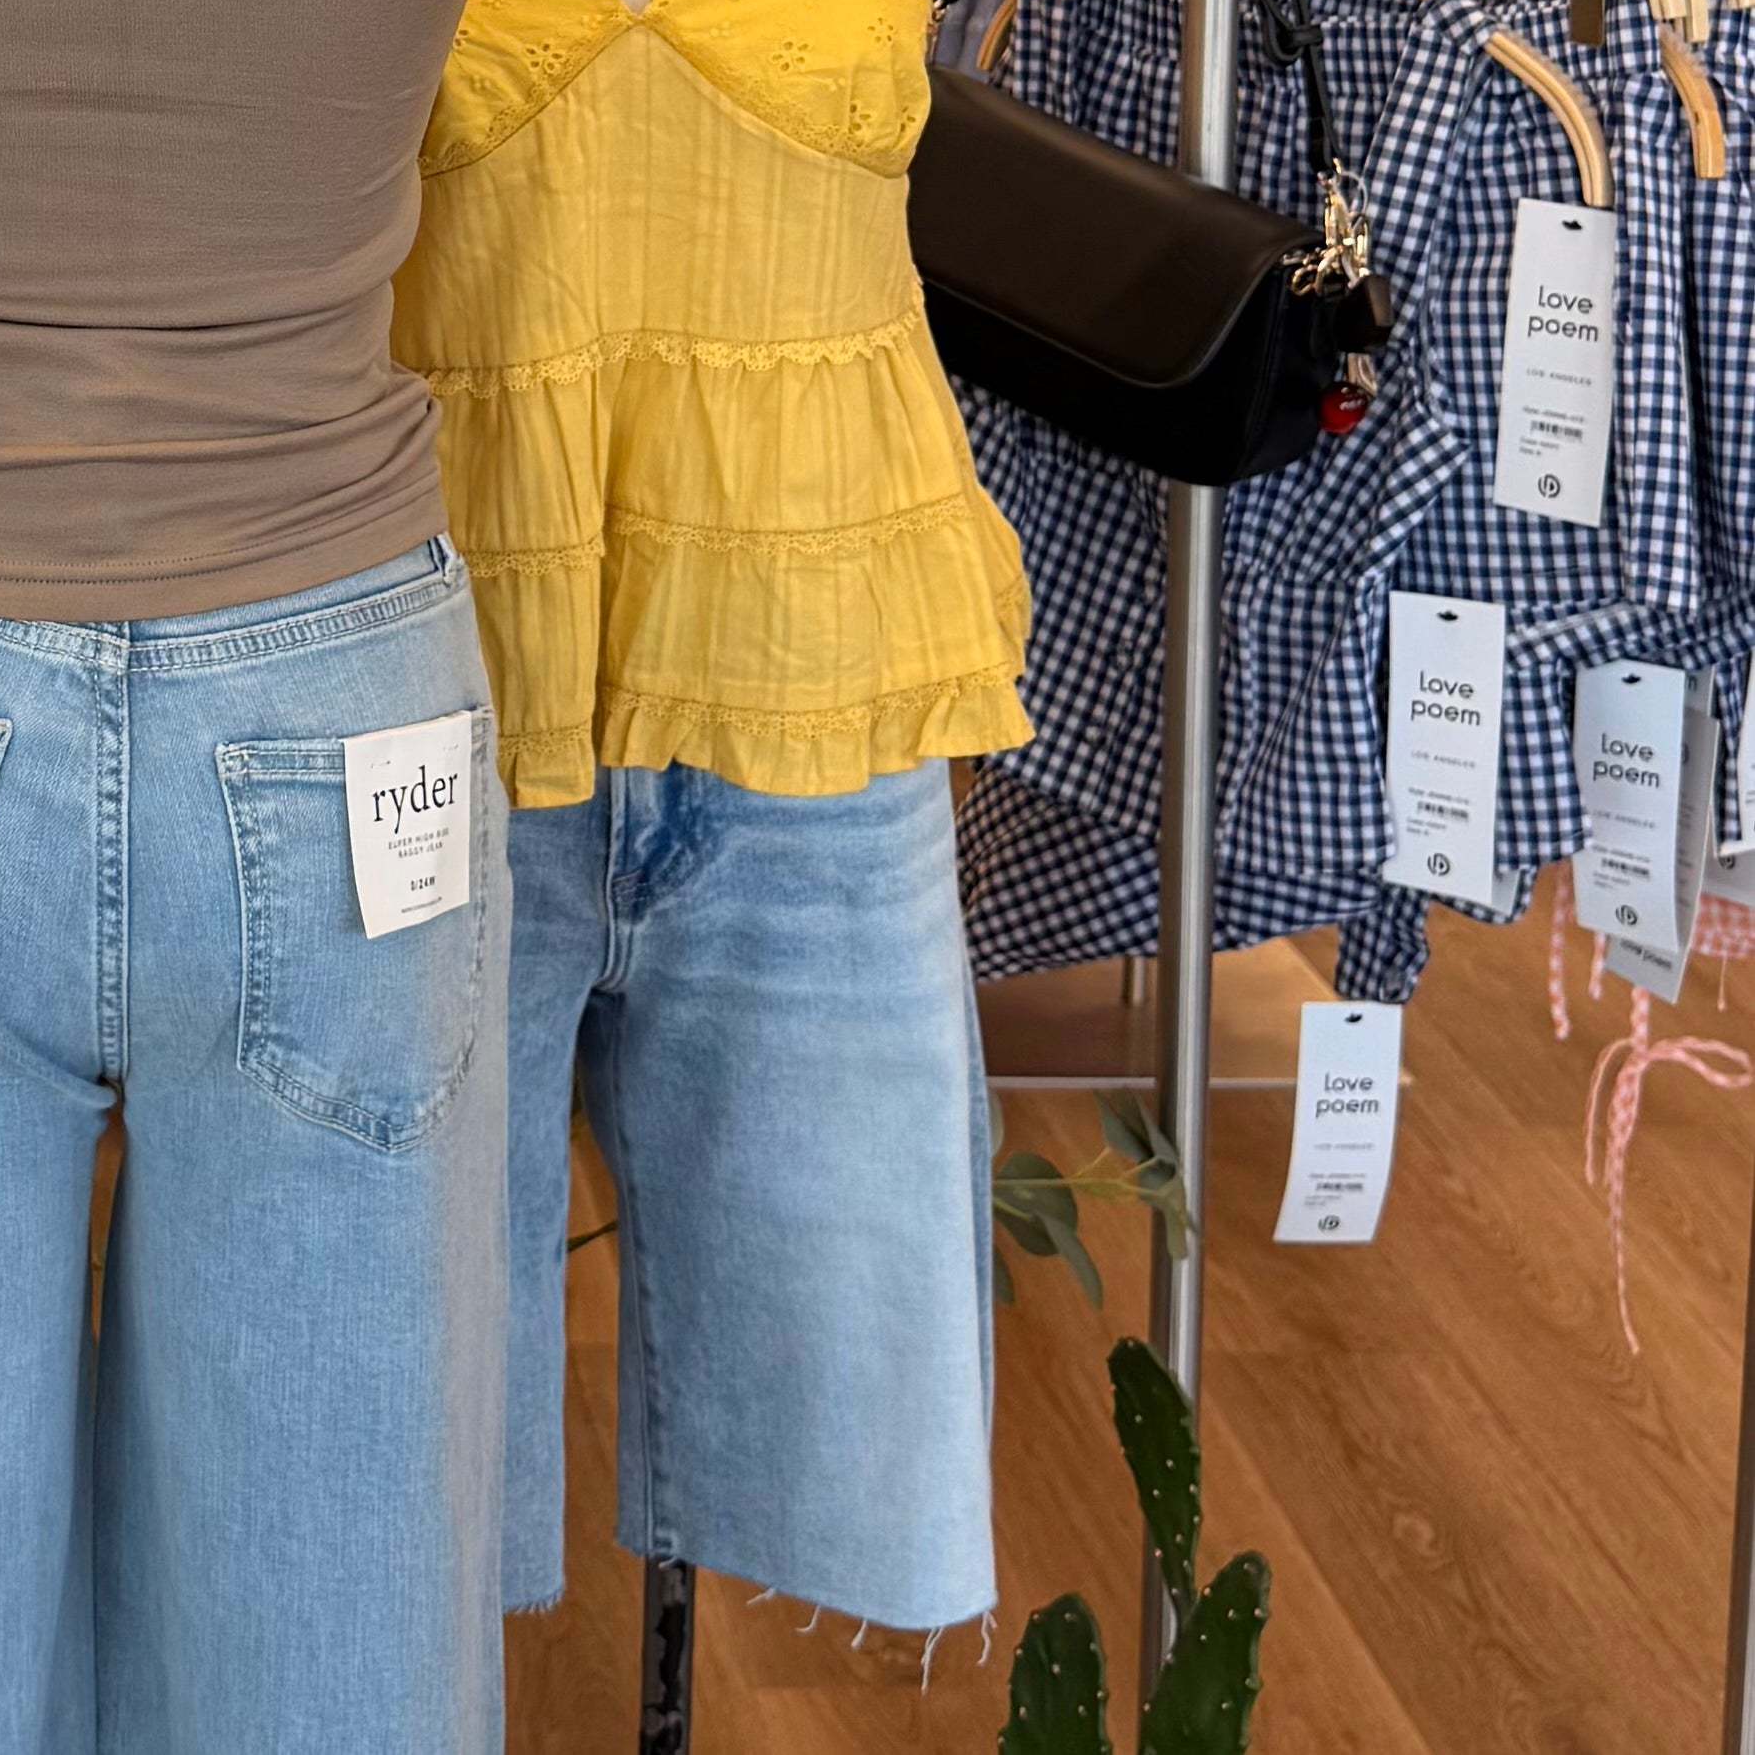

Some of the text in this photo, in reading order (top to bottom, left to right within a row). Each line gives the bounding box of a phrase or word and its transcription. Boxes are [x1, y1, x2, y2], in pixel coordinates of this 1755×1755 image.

[1527, 315, 1599, 342] poem
[1410, 699, 1481, 726] poem
[1593, 760, 1661, 789] poem
[372, 764, 458, 835] ryder
[1315, 1098, 1379, 1119] poem
